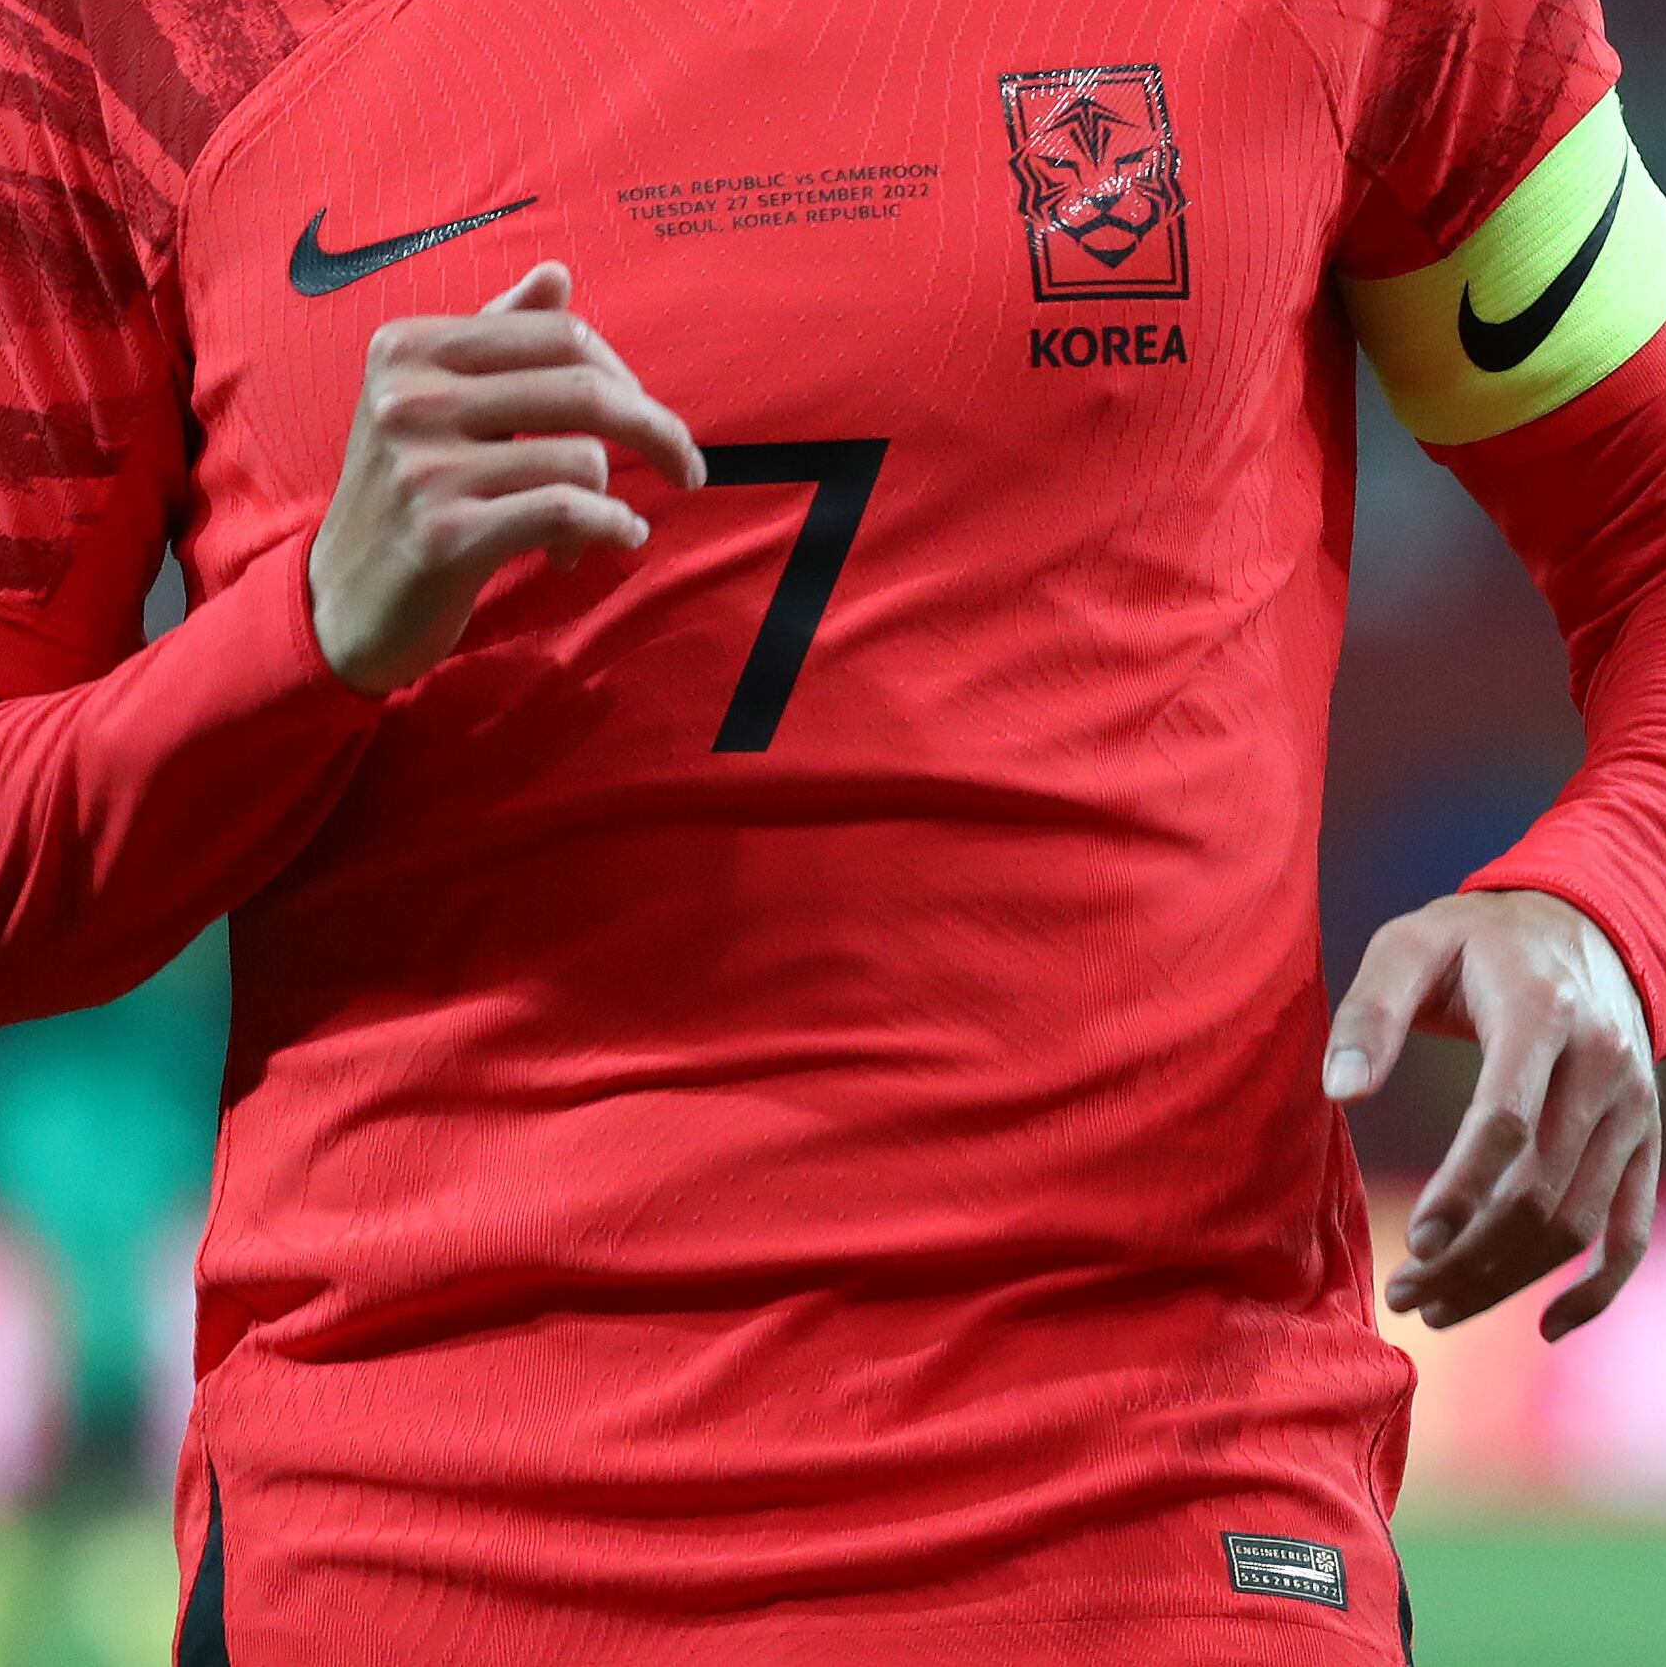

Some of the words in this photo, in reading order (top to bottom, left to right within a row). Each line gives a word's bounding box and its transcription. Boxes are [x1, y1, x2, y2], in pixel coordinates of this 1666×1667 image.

[617, 183, 682, 203] KOREA
[691, 173, 786, 195] REPUBLIC
[820, 163, 939, 183] CAMEROON
[631, 200, 718, 221] TUESDAY
[727, 196, 749, 211] 27
[757, 187, 874, 207] SEPTEMBER
[883, 183, 931, 199] 2022
[654, 219, 725, 238] SEOUL,
[733, 212, 797, 230] KOREA
[806, 204, 901, 223] REPUBLIC
[1030, 324, 1188, 368] KOREA
[700, 438, 891, 752] 7
[1235, 1545, 1310, 1562] ENGINEERED
